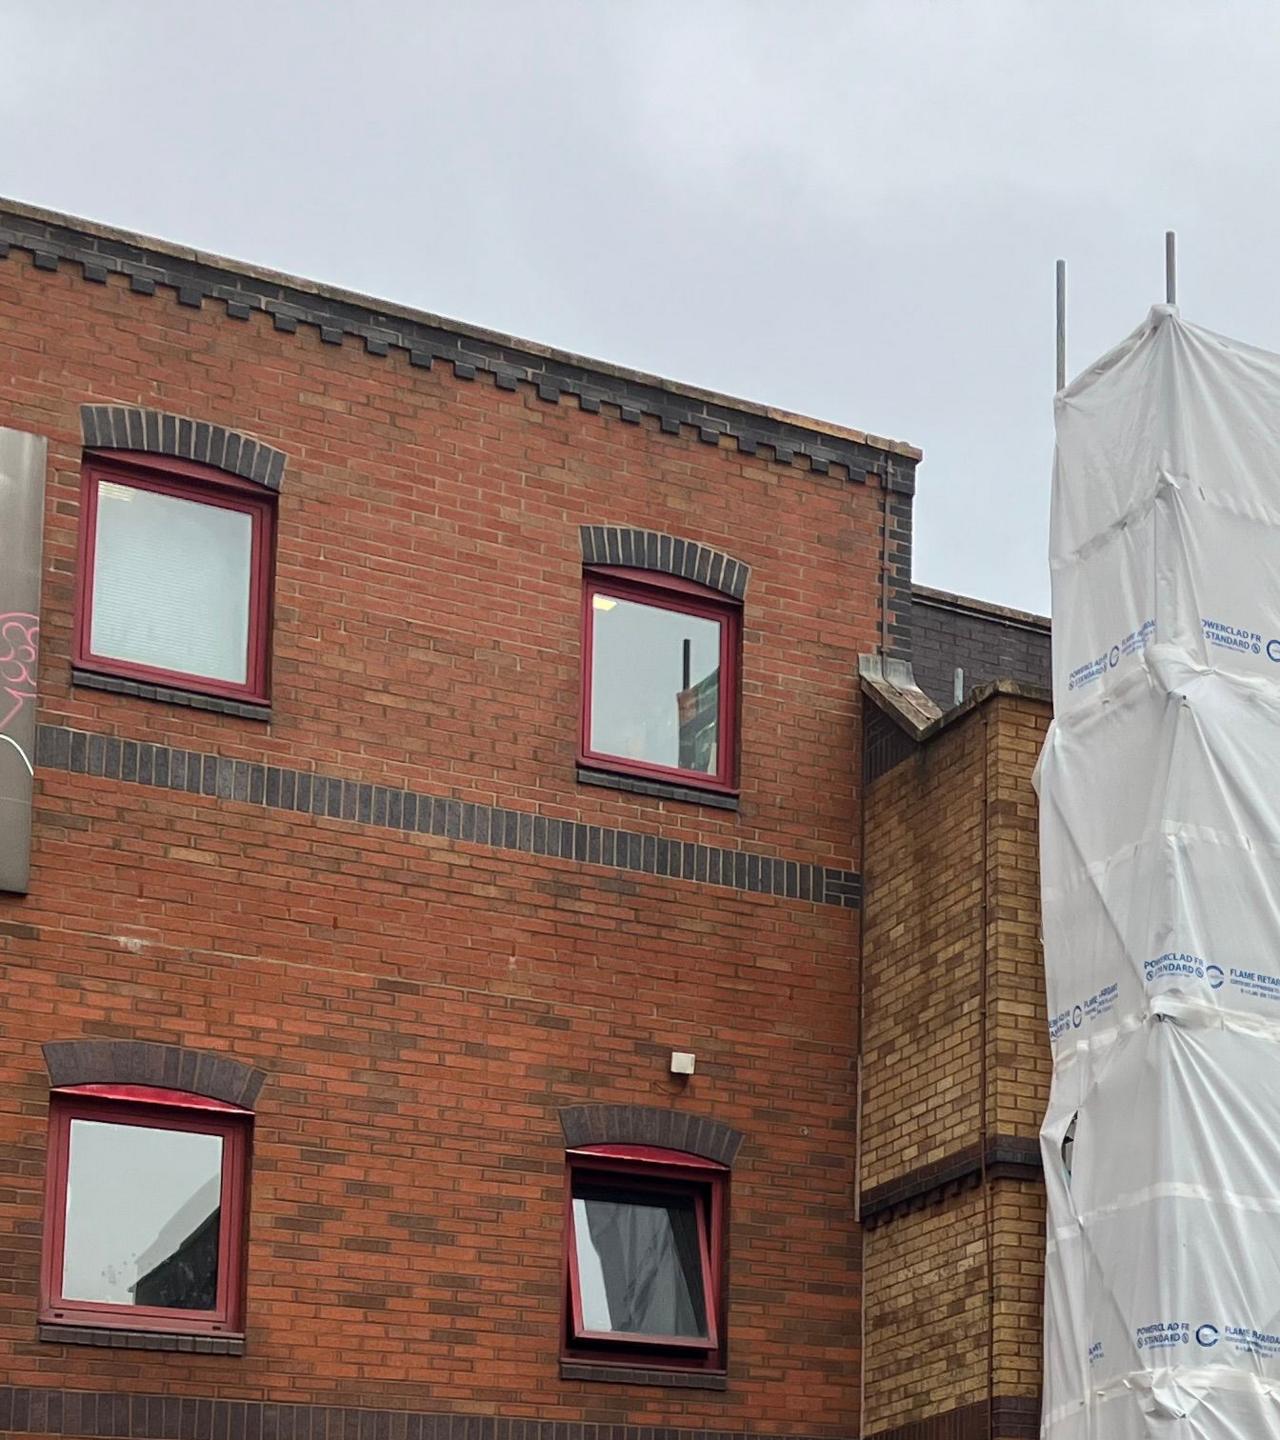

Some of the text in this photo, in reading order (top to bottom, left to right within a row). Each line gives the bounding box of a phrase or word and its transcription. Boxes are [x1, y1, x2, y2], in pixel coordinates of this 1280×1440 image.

[1205, 631, 1249, 649] STANDARD
[1251, 633, 1261, 642] FR
[1194, 957, 1204, 966] FR
[1230, 968, 1255, 981] FLAME
[1137, 1323, 1189, 1336] POWERCLAD FR
[1225, 1326, 1250, 1336] FLAME
